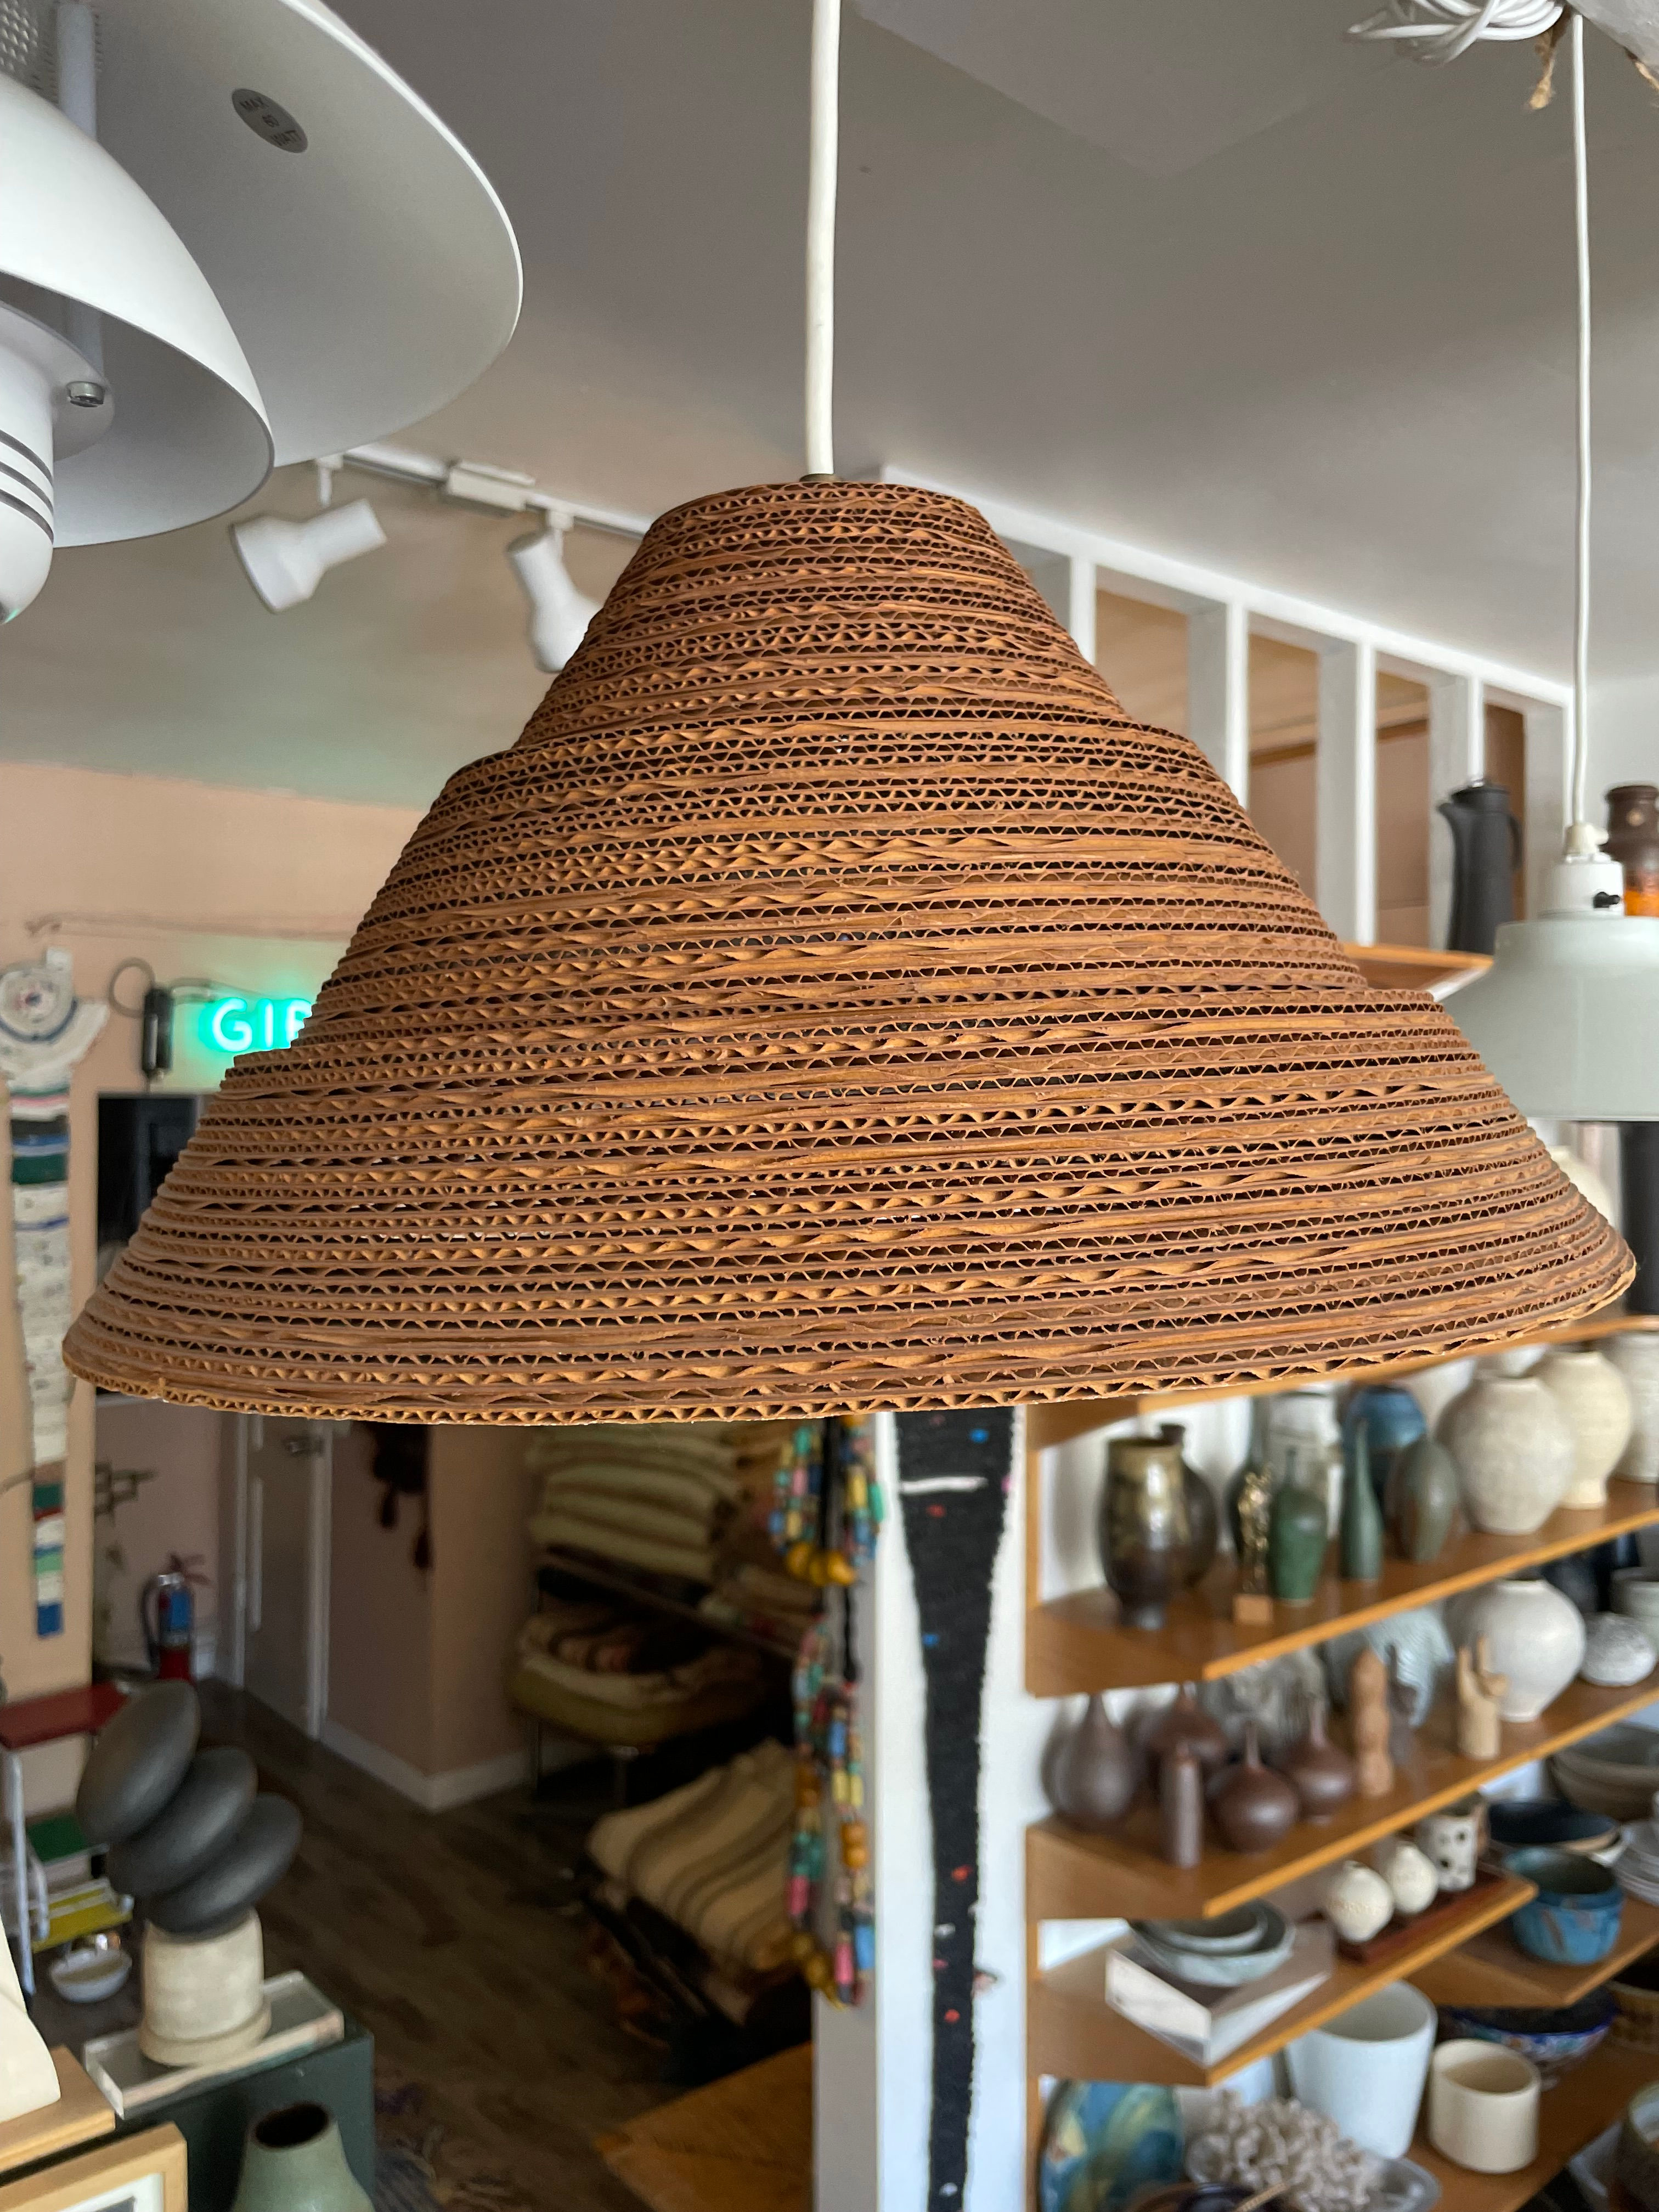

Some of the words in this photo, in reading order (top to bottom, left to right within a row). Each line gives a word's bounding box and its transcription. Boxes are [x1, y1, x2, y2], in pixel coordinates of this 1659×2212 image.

[239, 97, 269, 111] MAX
[262, 114, 280, 127] 60
[269, 130, 302, 146] WATT
